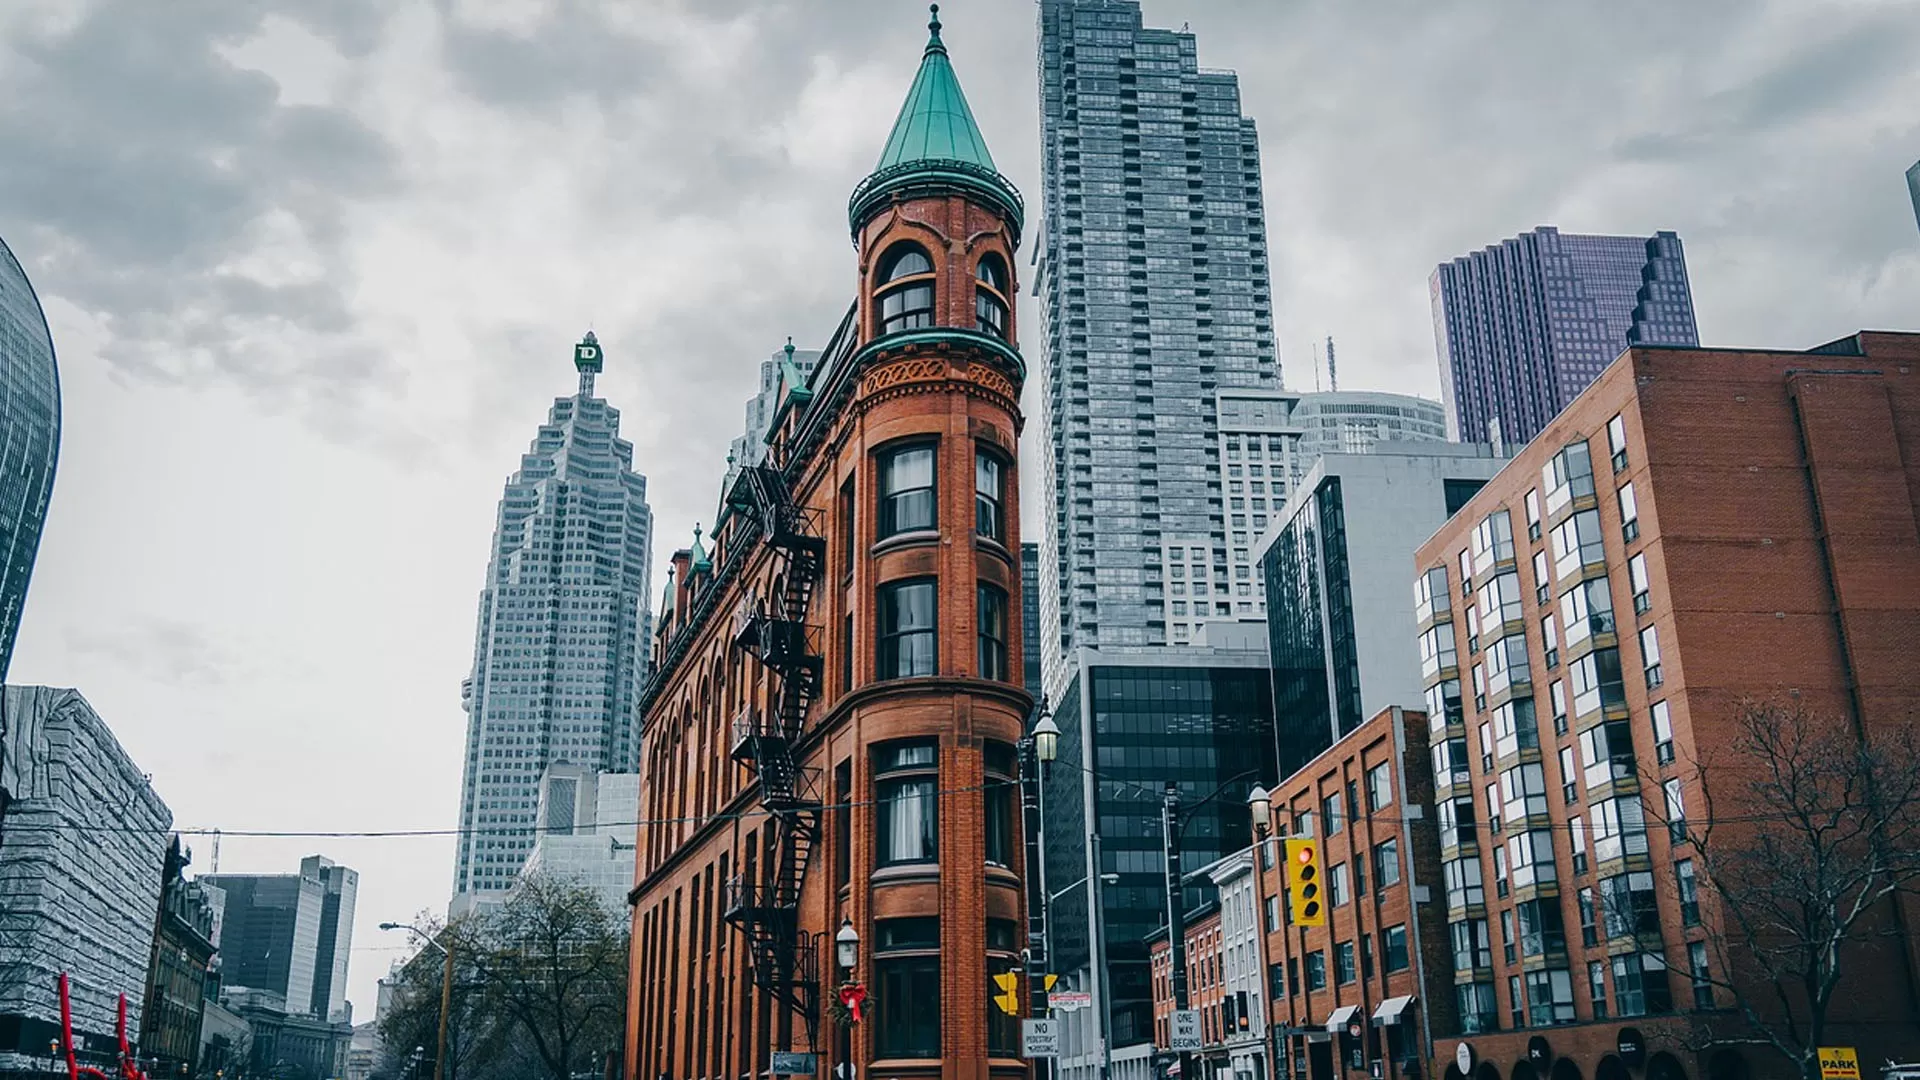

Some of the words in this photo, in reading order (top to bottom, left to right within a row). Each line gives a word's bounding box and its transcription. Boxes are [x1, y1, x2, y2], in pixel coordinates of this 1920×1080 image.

[578, 346, 597, 359] TD
[1177, 1013, 1193, 1023] ONE
[1034, 1023, 1048, 1034] NO
[1178, 1026, 1193, 1035] WAY
[1172, 1038, 1201, 1048] BEGINS
[1822, 1060, 1856, 1069] PARK
